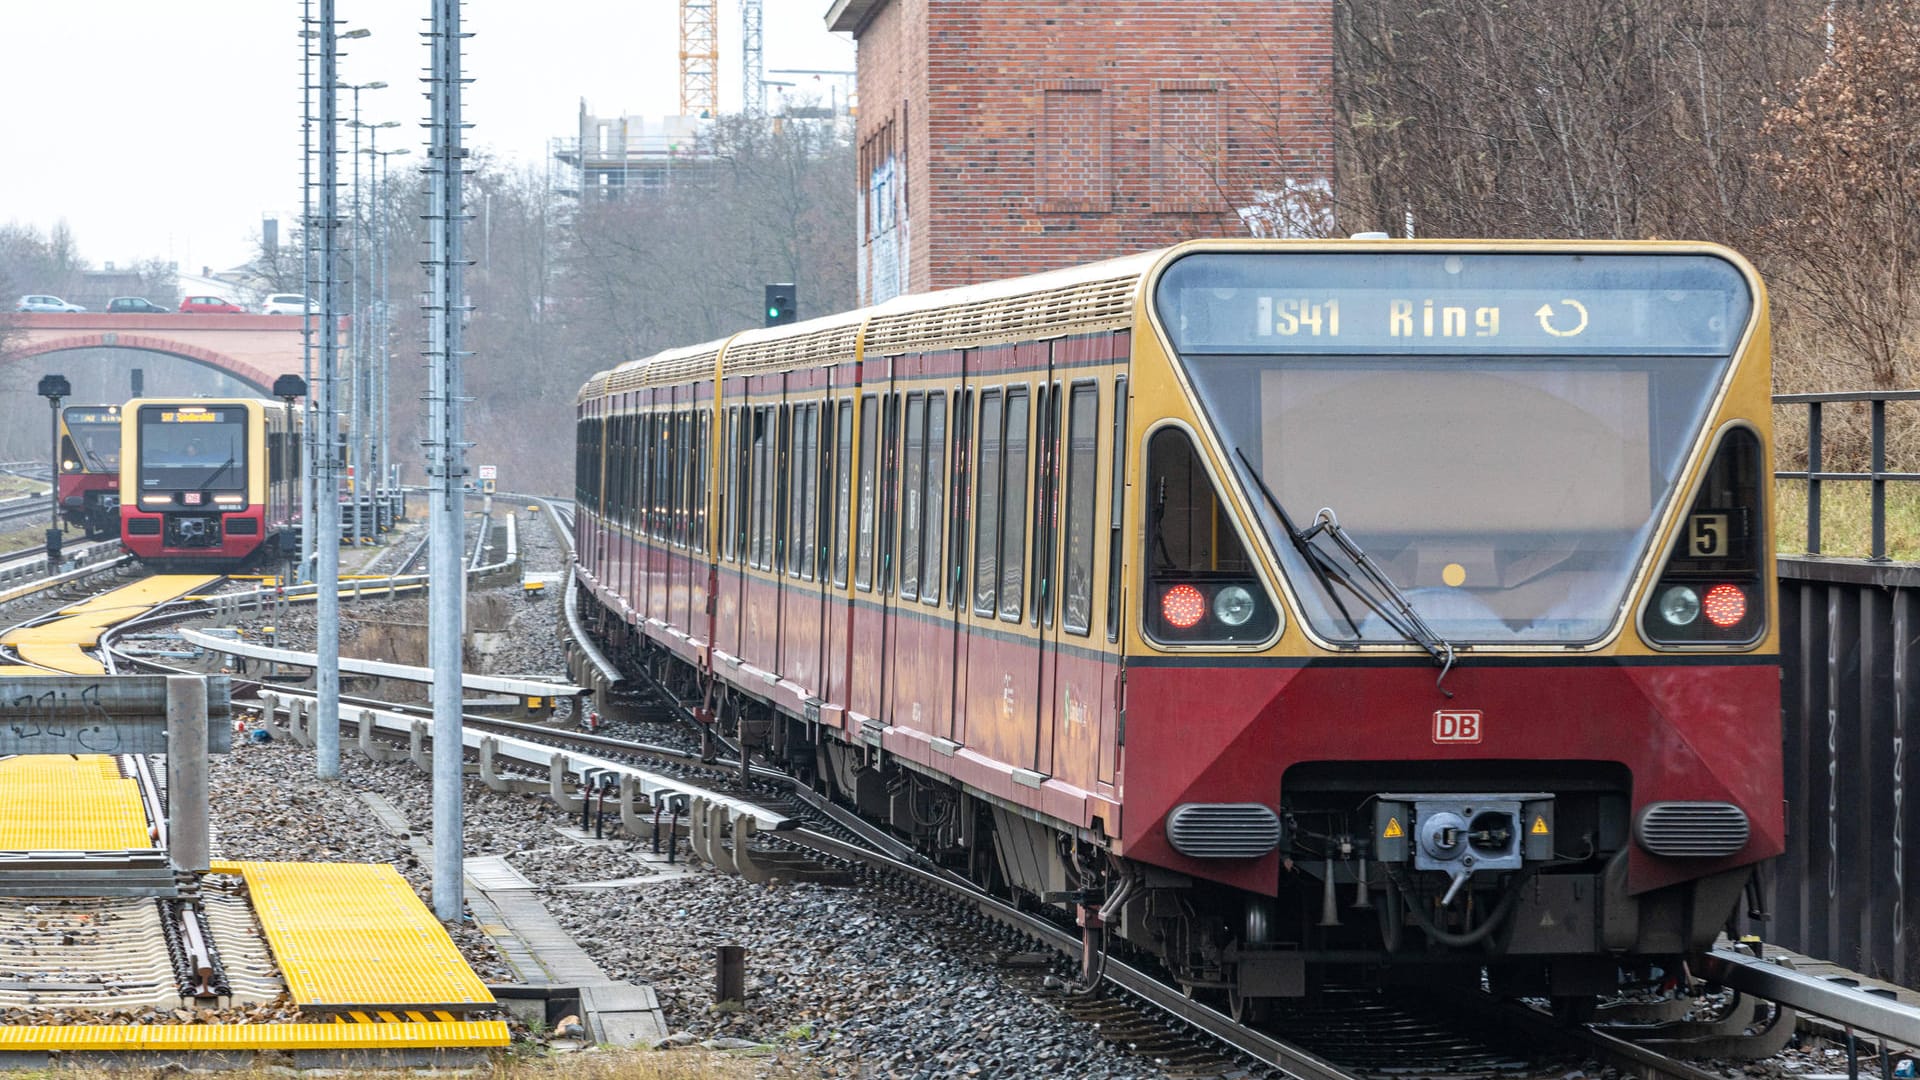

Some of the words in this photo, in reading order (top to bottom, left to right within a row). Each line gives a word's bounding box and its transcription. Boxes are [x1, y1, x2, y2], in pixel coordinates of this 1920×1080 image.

[1276, 299, 1339, 336] S41
[1390, 299, 1500, 336] Ring
[1696, 517, 1718, 554] 5
[1440, 715, 1476, 738] DB
